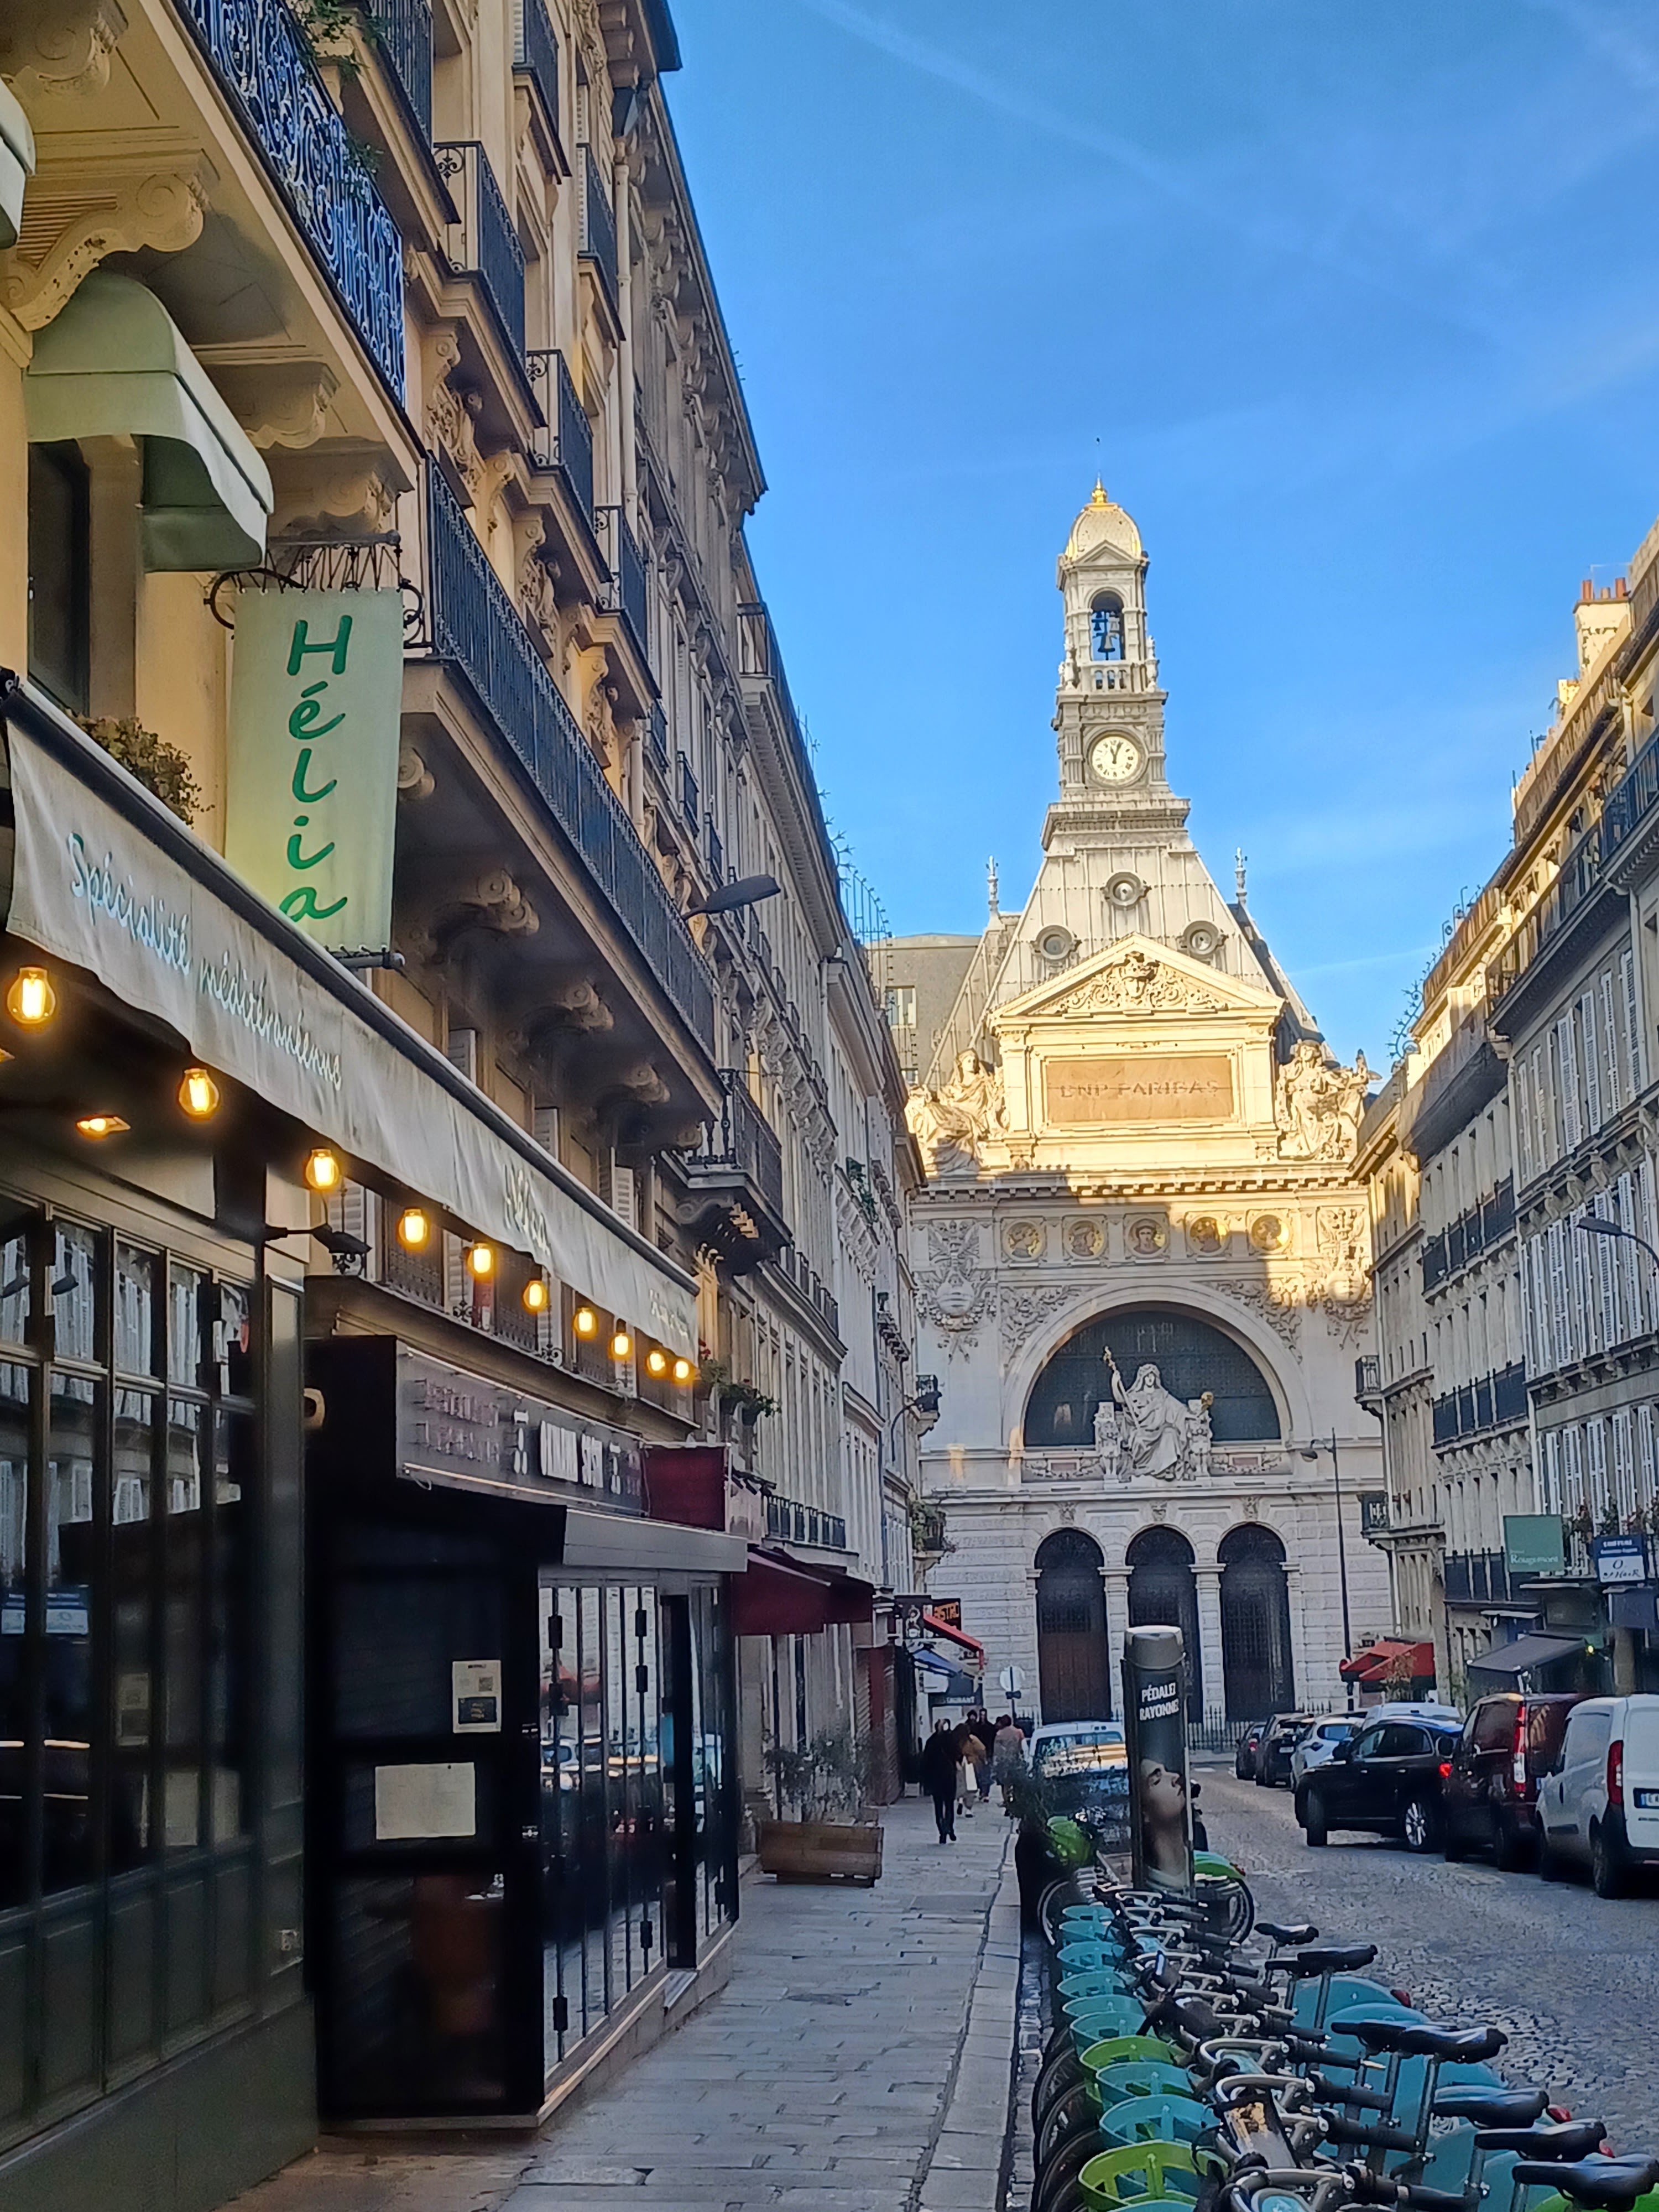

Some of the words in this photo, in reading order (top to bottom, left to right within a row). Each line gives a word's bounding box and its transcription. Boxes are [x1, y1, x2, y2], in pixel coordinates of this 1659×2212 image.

[279, 614, 353, 922] Hélia
[68, 832, 193, 977] Spécialité
[1060, 1083, 1109, 1098] BNP
[1117, 1080, 1218, 1097] PARIBAS
